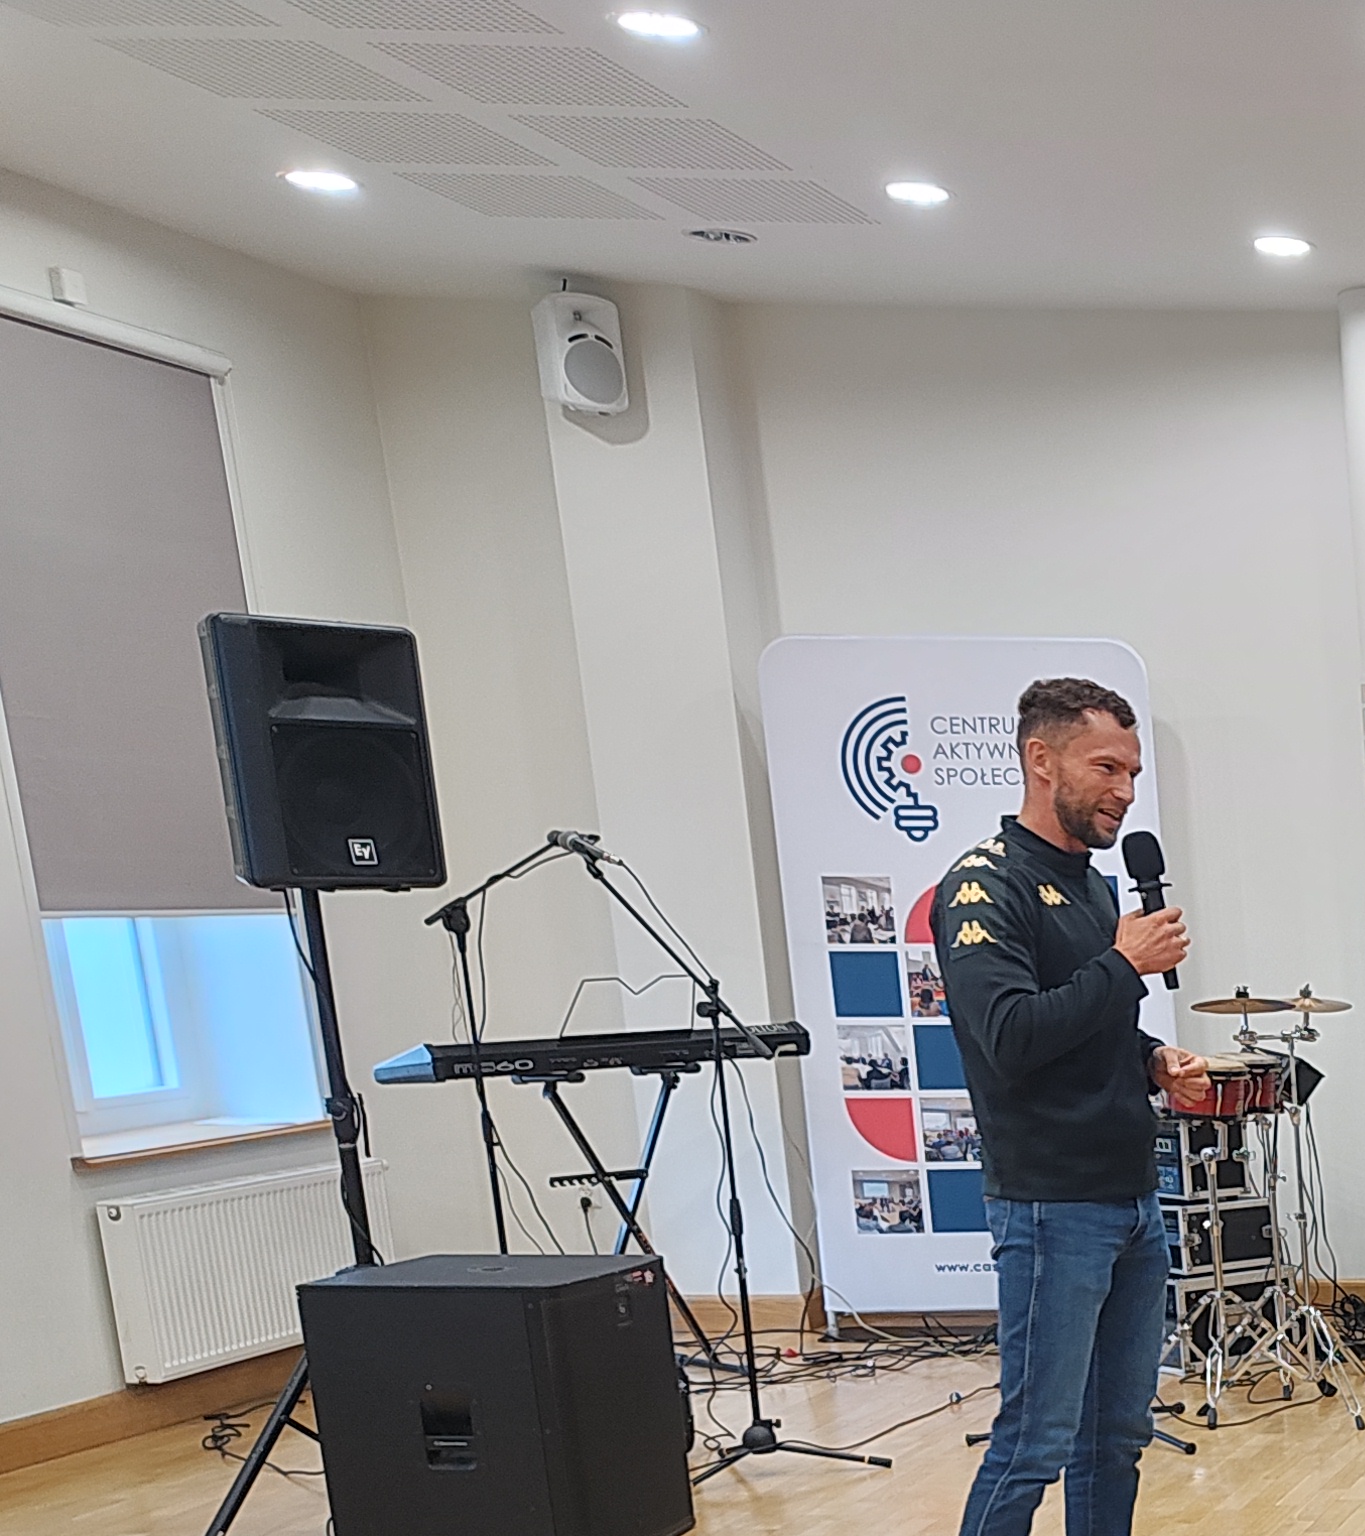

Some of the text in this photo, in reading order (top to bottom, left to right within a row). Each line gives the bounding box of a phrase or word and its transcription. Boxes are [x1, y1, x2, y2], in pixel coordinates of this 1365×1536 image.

[930, 715, 1016, 735] CENTRU
[932, 741, 1021, 760] AKTYWN
[934, 766, 1023, 786] SPOŁEC
